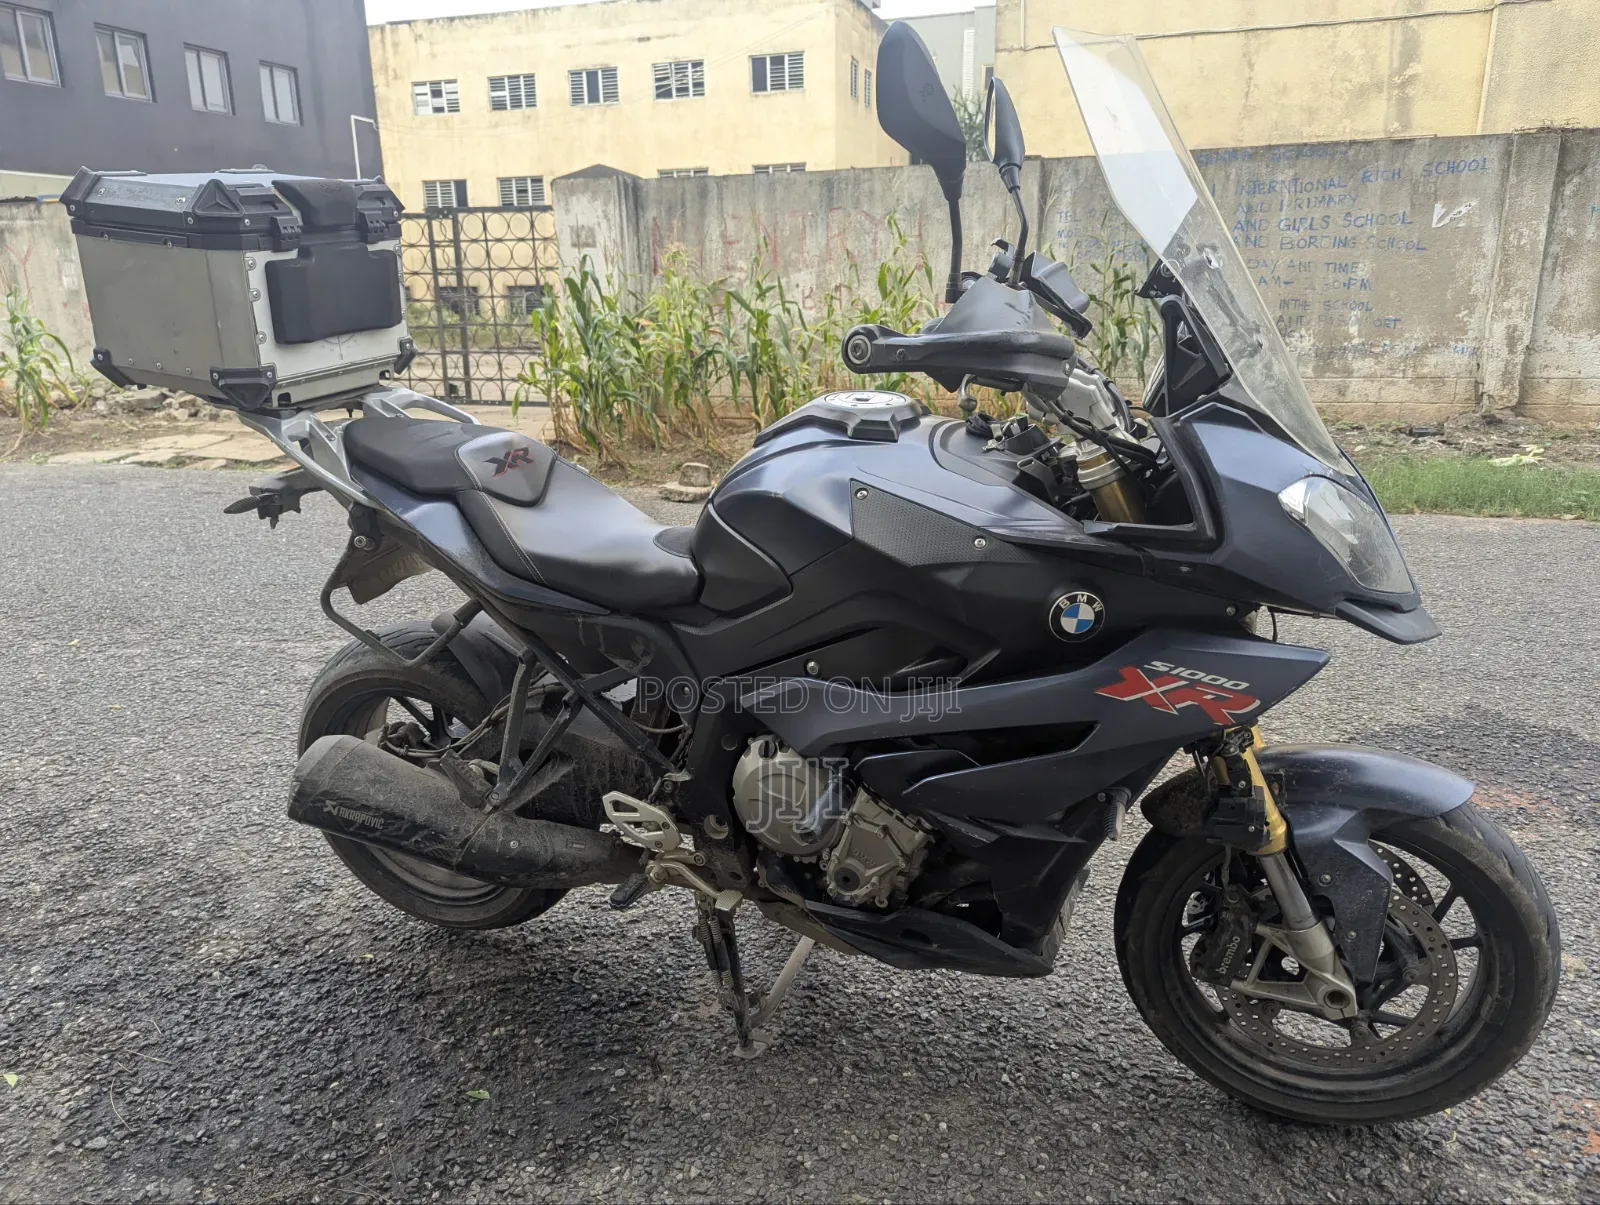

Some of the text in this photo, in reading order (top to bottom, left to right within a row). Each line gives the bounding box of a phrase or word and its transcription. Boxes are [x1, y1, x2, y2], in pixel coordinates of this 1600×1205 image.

[1361, 168, 1402, 185] RICH
[1420, 157, 1488, 178] SCHOOL
[1233, 210, 1413, 234] AND GIRLS SCHOOL
[1232, 236, 1270, 249] AND
[1366, 236, 1427, 251] SCHOOL
[1247, 258, 1279, 275] DAY
[1323, 300, 1374, 313] SCHOOL
[1143, 660, 1250, 690] S1000
[1093, 665, 1261, 725] XR
[1215, 936, 1241, 975] brembo
